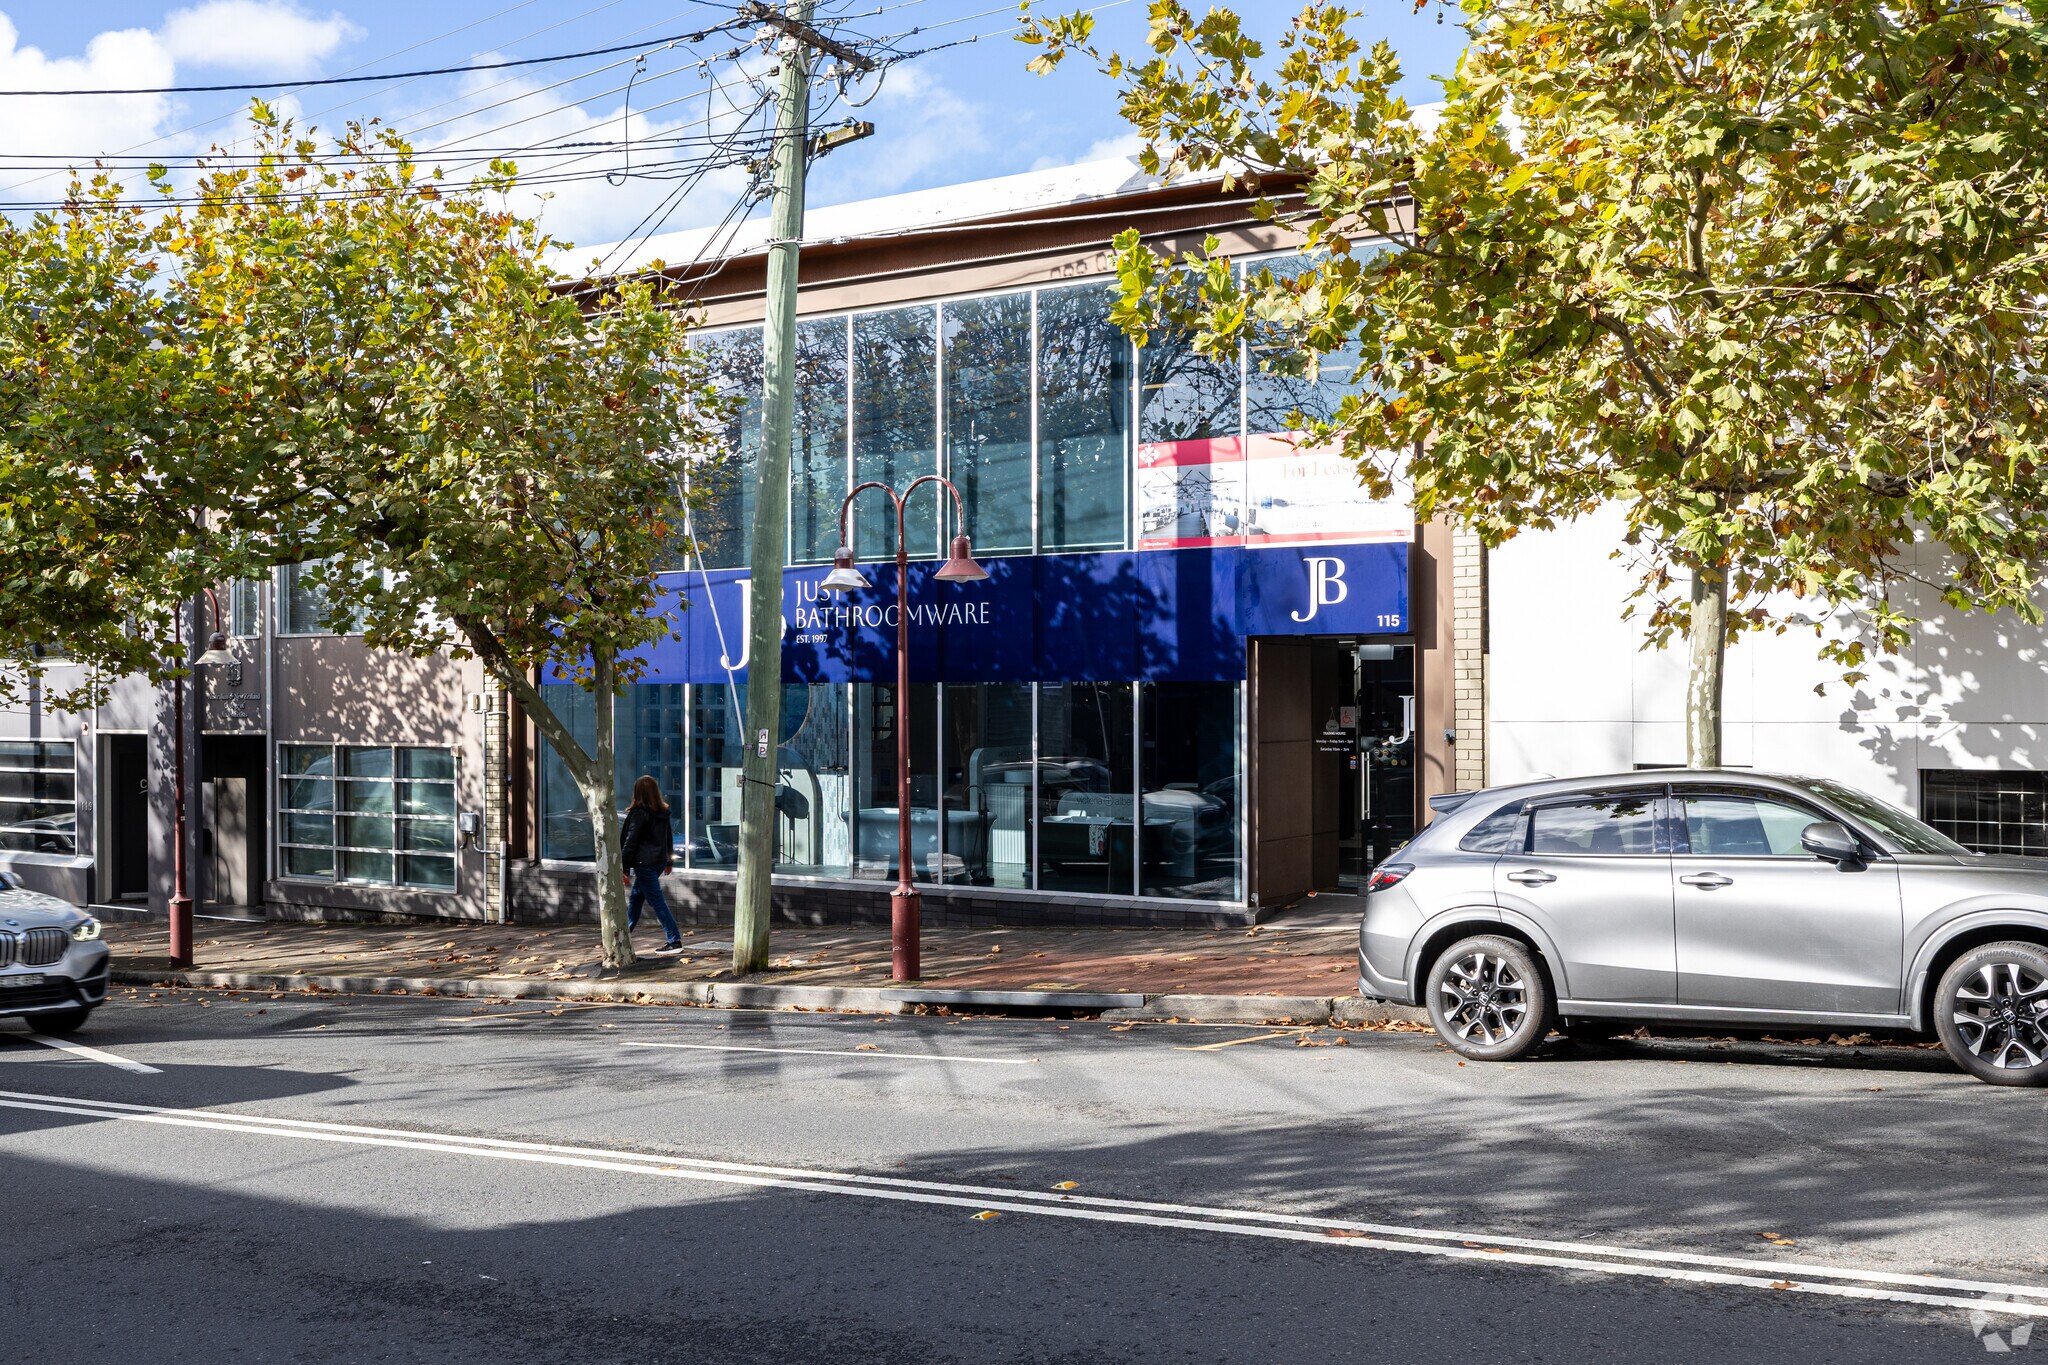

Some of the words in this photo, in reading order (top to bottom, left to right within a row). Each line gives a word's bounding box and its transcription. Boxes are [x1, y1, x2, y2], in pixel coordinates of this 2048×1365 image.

[1282, 462, 1306, 479] For
[1313, 461, 1357, 477] Lease
[1291, 557, 1348, 623] JB
[795, 602, 990, 630] BATHROOMWARE
[1377, 614, 1400, 627] 115
[796, 634, 810, 643] EST.
[812, 634, 828, 643] 1997
[81, 801, 93, 811] 119
